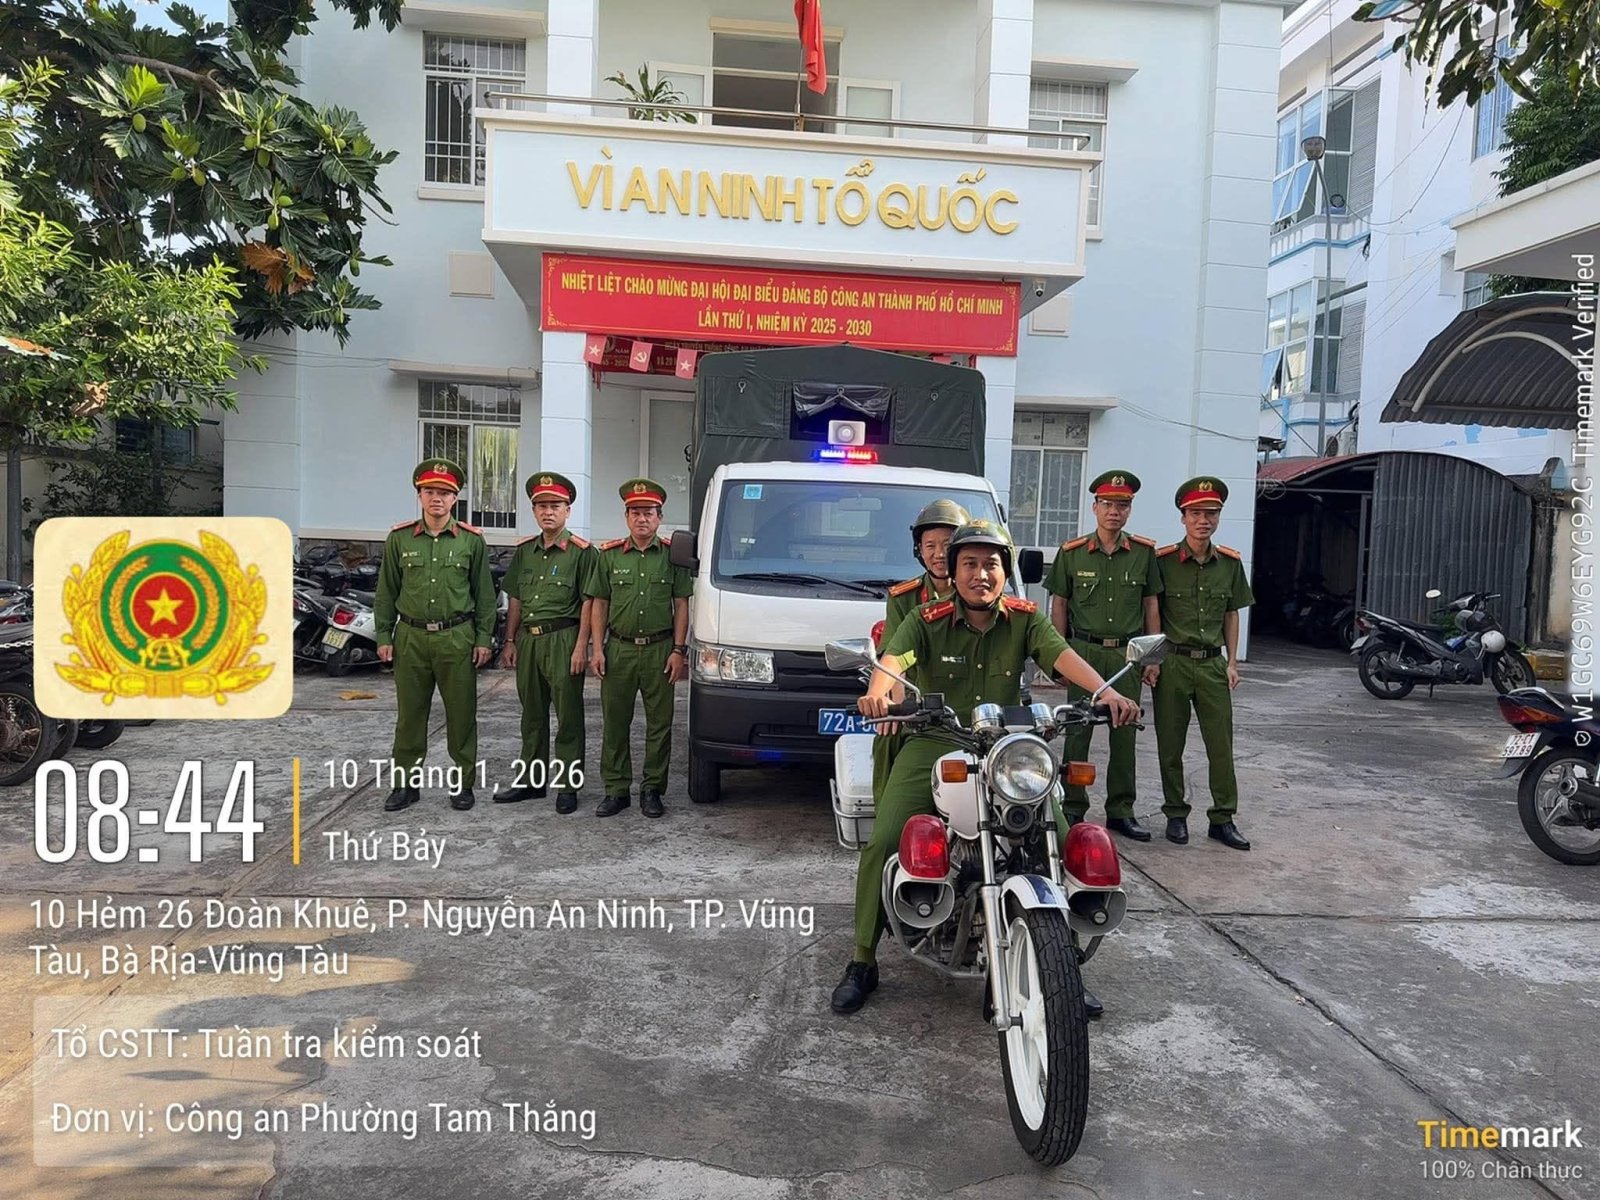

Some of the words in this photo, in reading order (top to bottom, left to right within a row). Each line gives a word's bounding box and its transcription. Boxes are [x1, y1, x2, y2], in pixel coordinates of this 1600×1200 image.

[566, 145, 614, 210] VÌ
[619, 165, 691, 216] AN
[698, 170, 805, 223] NINH
[811, 158, 876, 226] TỔ
[877, 167, 1019, 235] QUỐC
[561, 270, 595, 294] NHIỆT
[597, 271, 622, 296] LIỆT
[624, 273, 654, 296] CHÀO
[656, 275, 688, 298] MỪNG
[691, 280, 708, 301] ĐẠI
[712, 277, 731, 301] HỘI
[733, 283, 752, 305] ĐẠI
[754, 277, 780, 304] BIỂU
[782, 281, 811, 305] ĐẢNG
[813, 285, 828, 309] BỘ
[831, 286, 859, 308] CÔNG
[861, 291, 876, 309] AN
[878, 288, 914, 311] THÀNH
[915, 287, 937, 312] PHỐ
[939, 288, 954, 313] HỒ
[956, 294, 975, 314] CHÍ
[976, 298, 1004, 316] MINH
[698, 304, 719, 329] LẦN
[722, 309, 745, 330] THỨ
[746, 312, 754, 333] I,
[756, 313, 790, 335] NHIỆM
[792, 312, 807, 334] KỲ
[810, 317, 837, 335] 2025
[845, 319, 873, 337] 2030
